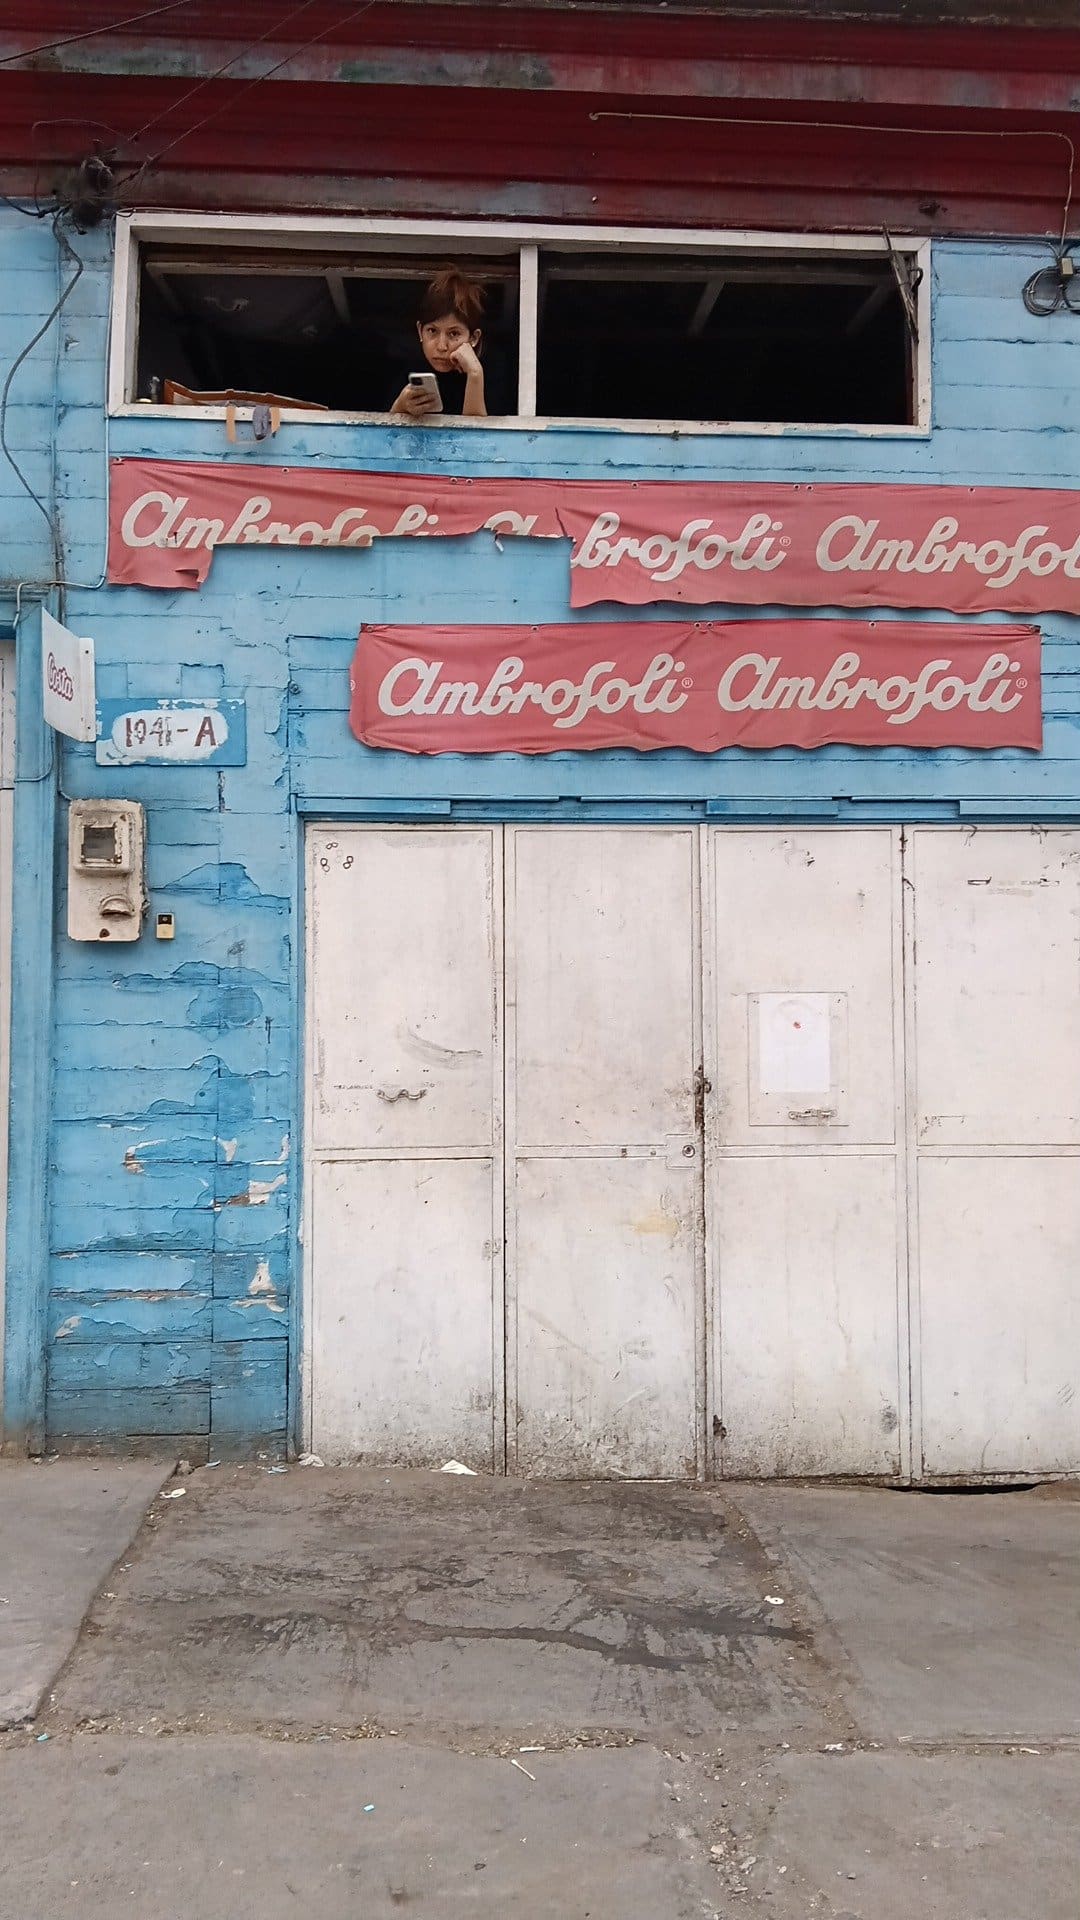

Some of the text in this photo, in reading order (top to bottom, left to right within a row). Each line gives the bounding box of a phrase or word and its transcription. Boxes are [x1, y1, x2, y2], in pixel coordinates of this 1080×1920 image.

[815, 515, 1080, 589] Ambroso
[378, 652, 1023, 729] Ambrosoli Ambrosoli
